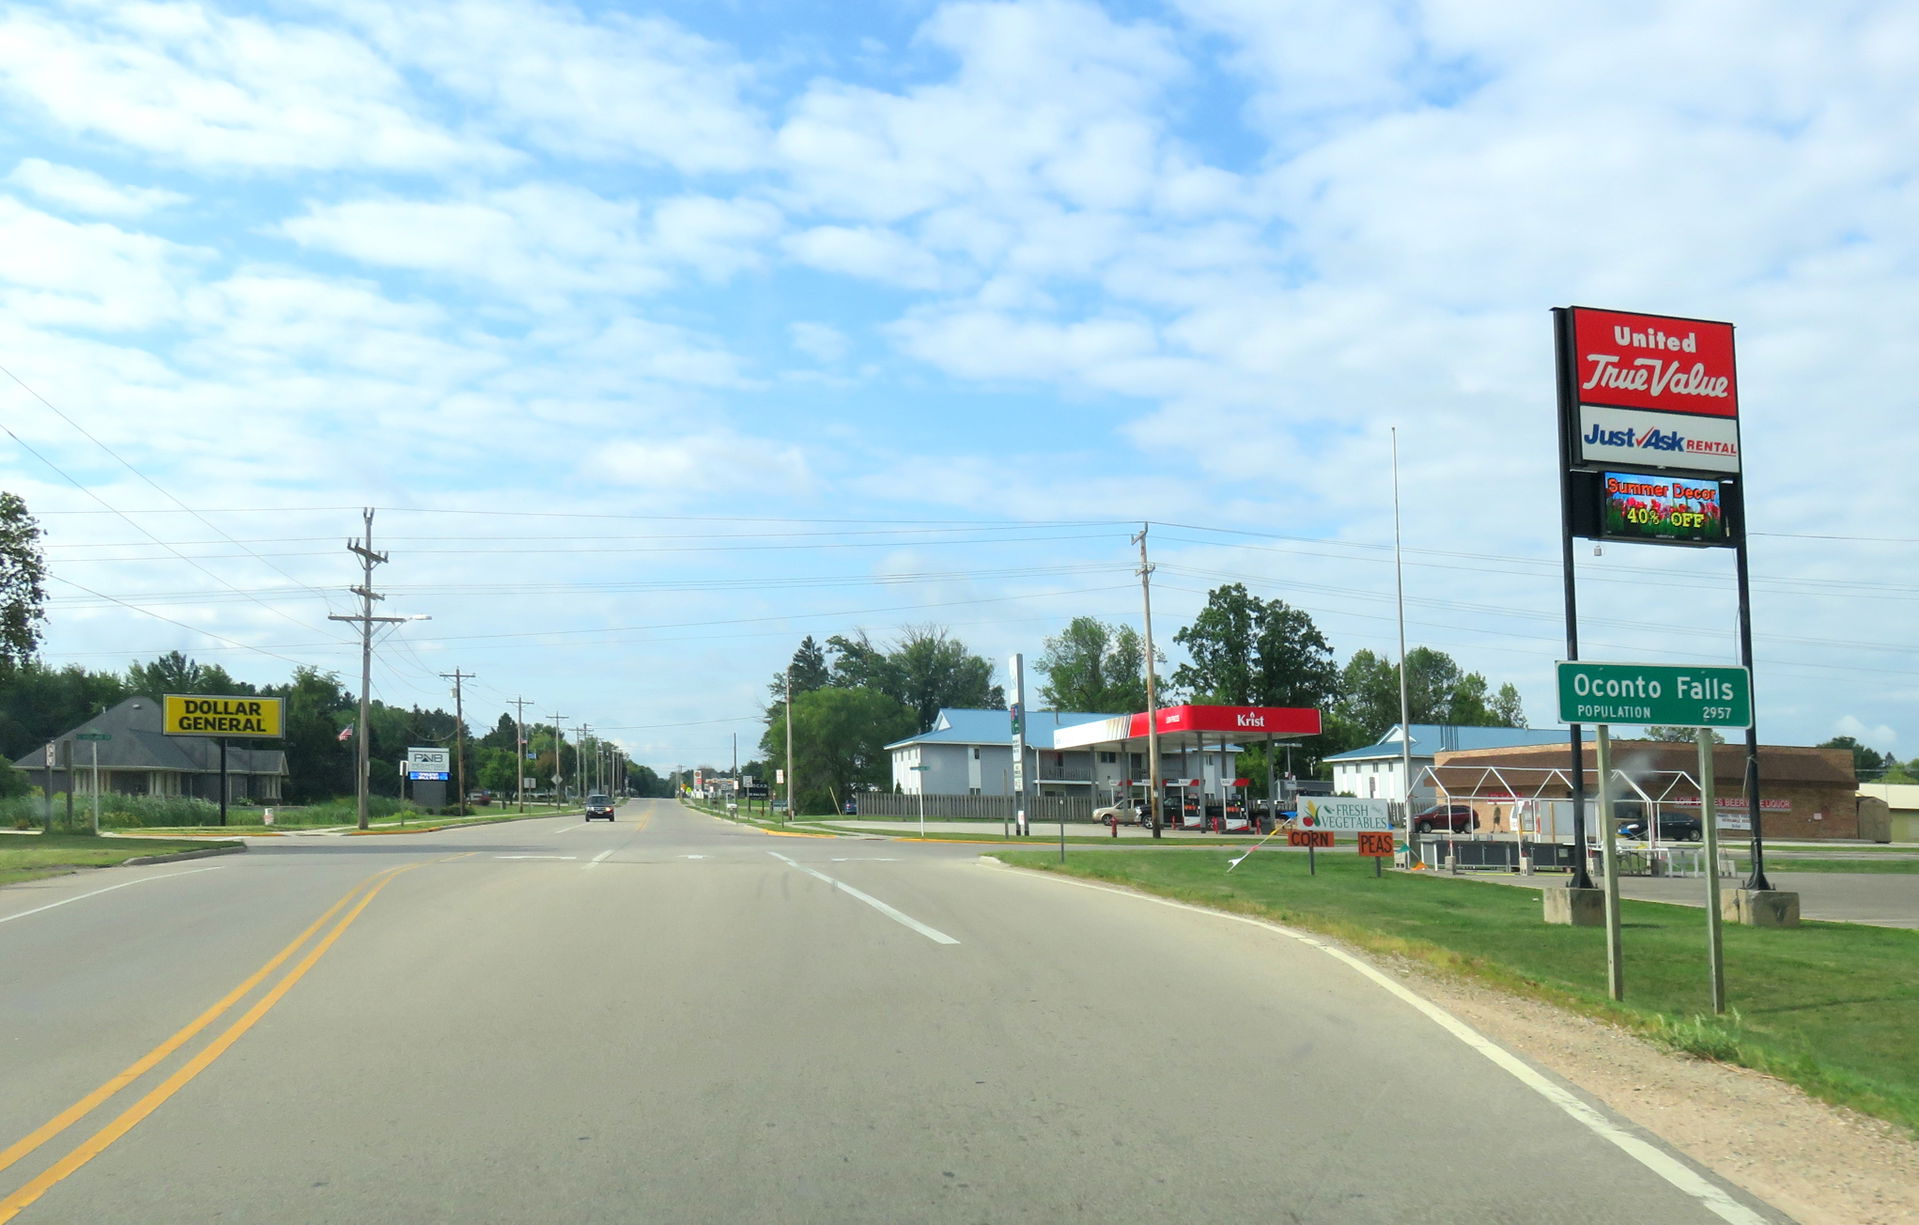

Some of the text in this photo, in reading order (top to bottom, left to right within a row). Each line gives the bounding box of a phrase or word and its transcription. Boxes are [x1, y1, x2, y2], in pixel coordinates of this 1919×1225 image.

[1614, 325, 1697, 353] United
[1584, 424, 1737, 455] Just Ask RENTAL
[1607, 477, 1717, 501] Summer Decor
[1627, 507, 1705, 528] 40% OFF
[1574, 673, 1734, 701] Oconto Falls
[184, 700, 261, 716] DOLLAR
[1577, 704, 1732, 720] POPULATION 2957
[179, 716, 267, 732] GENERAL
[1237, 712, 1265, 727] Krist
[1336, 804, 1369, 817] FRESH
[1725, 798, 1744, 808] BEER
[1321, 816, 1387, 830] VEGETABLES
[1291, 831, 1329, 847] CORN
[1360, 835, 1393, 854] PEAS
